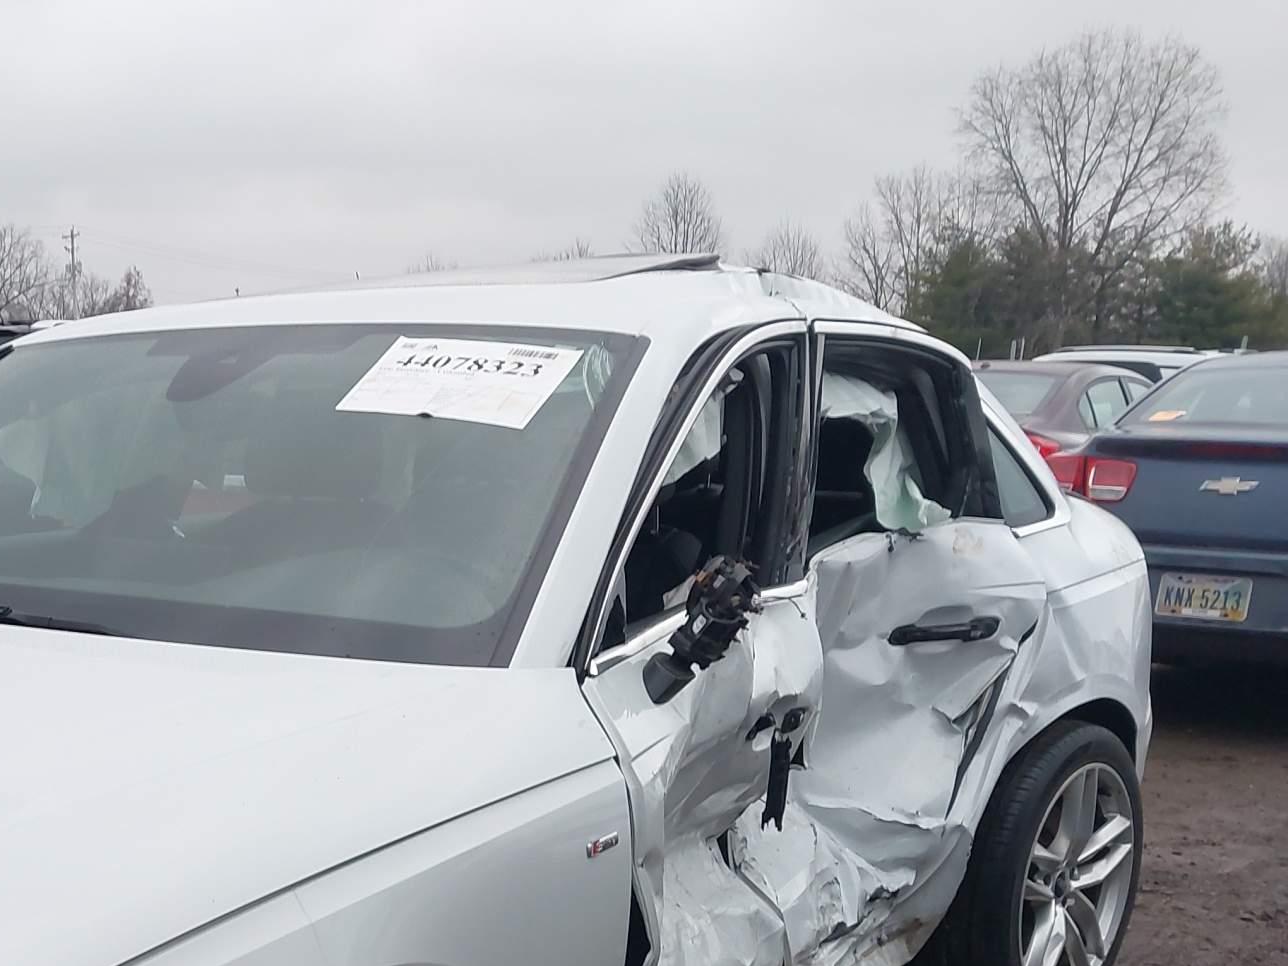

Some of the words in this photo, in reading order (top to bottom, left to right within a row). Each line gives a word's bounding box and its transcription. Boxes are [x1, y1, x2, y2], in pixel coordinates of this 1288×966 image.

[396, 354, 543, 377] 44078323
[1164, 586, 1196, 608] KNX
[1200, 588, 1242, 611] 5213
